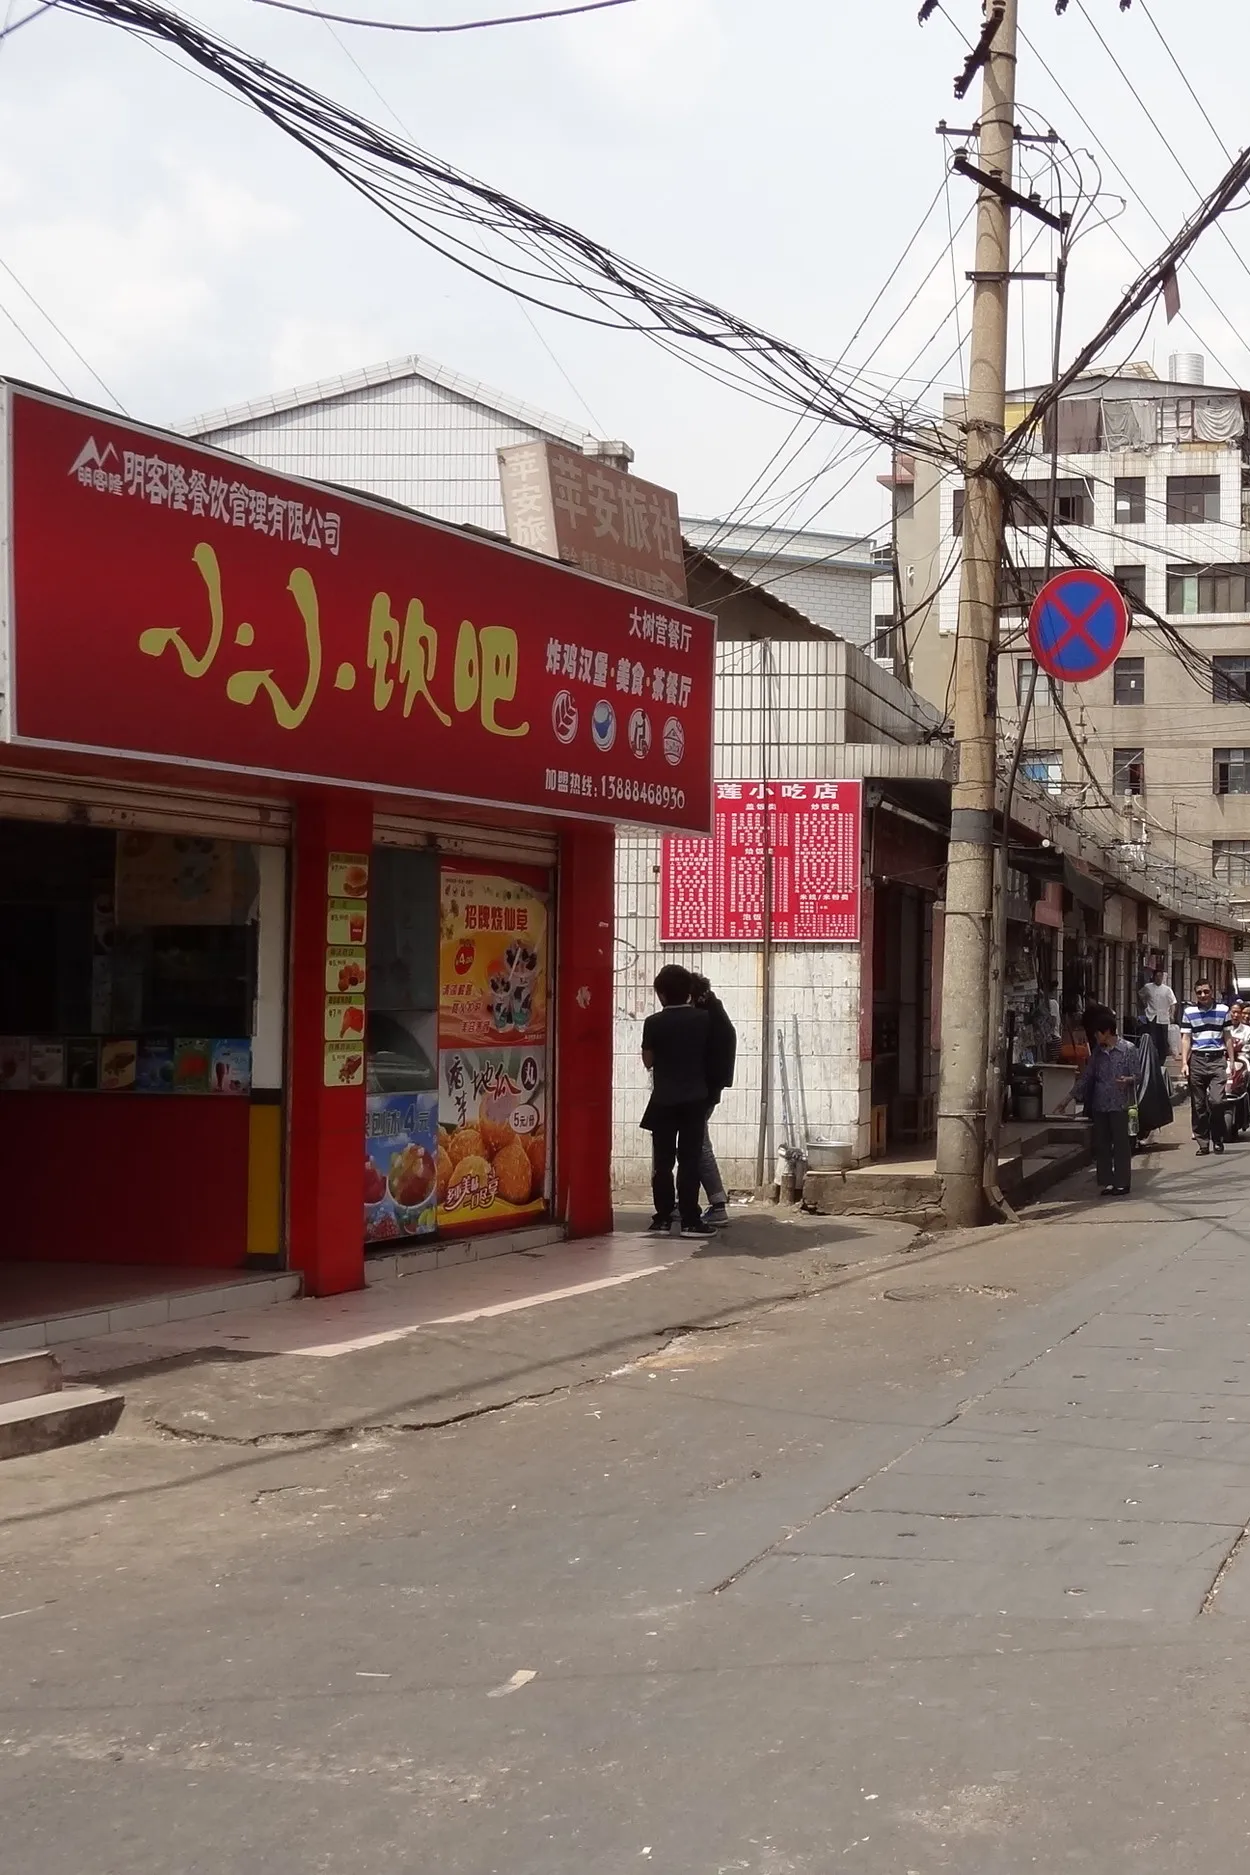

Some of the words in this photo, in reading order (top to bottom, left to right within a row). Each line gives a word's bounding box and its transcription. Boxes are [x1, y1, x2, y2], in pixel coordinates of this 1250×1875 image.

[77, 466, 123, 496] 明客隆
[123, 450, 341, 556] 明客隆餐饮管理有限公司
[507, 450, 548, 554] 苹安旅
[551, 454, 682, 564] 苹安旅社
[139, 542, 530, 738] 小小饮吧
[629, 606, 693, 653] 大树营餐厅
